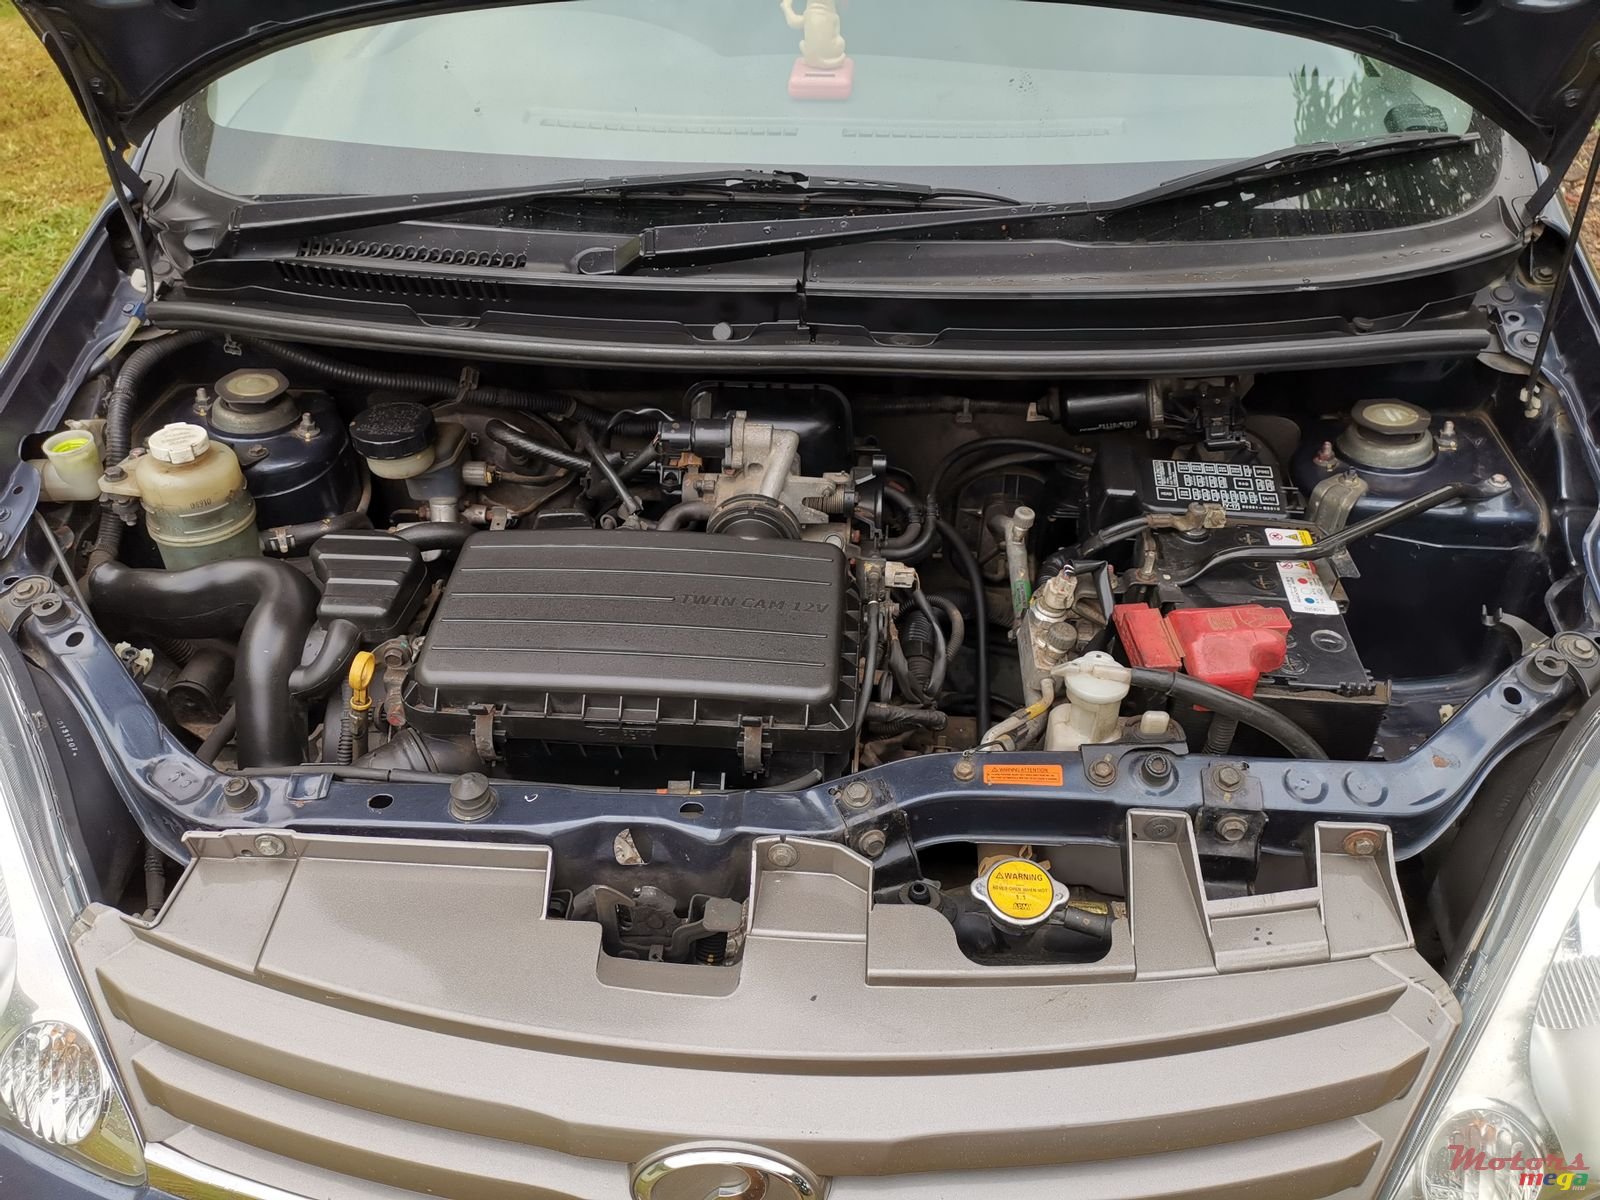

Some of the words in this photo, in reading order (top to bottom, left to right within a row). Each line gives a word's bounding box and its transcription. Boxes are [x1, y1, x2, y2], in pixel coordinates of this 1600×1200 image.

[683, 594, 736, 607] TWIN
[740, 598, 785, 610] CAM
[793, 602, 830, 613] 12V
[1004, 872, 1043, 881] WARNING
